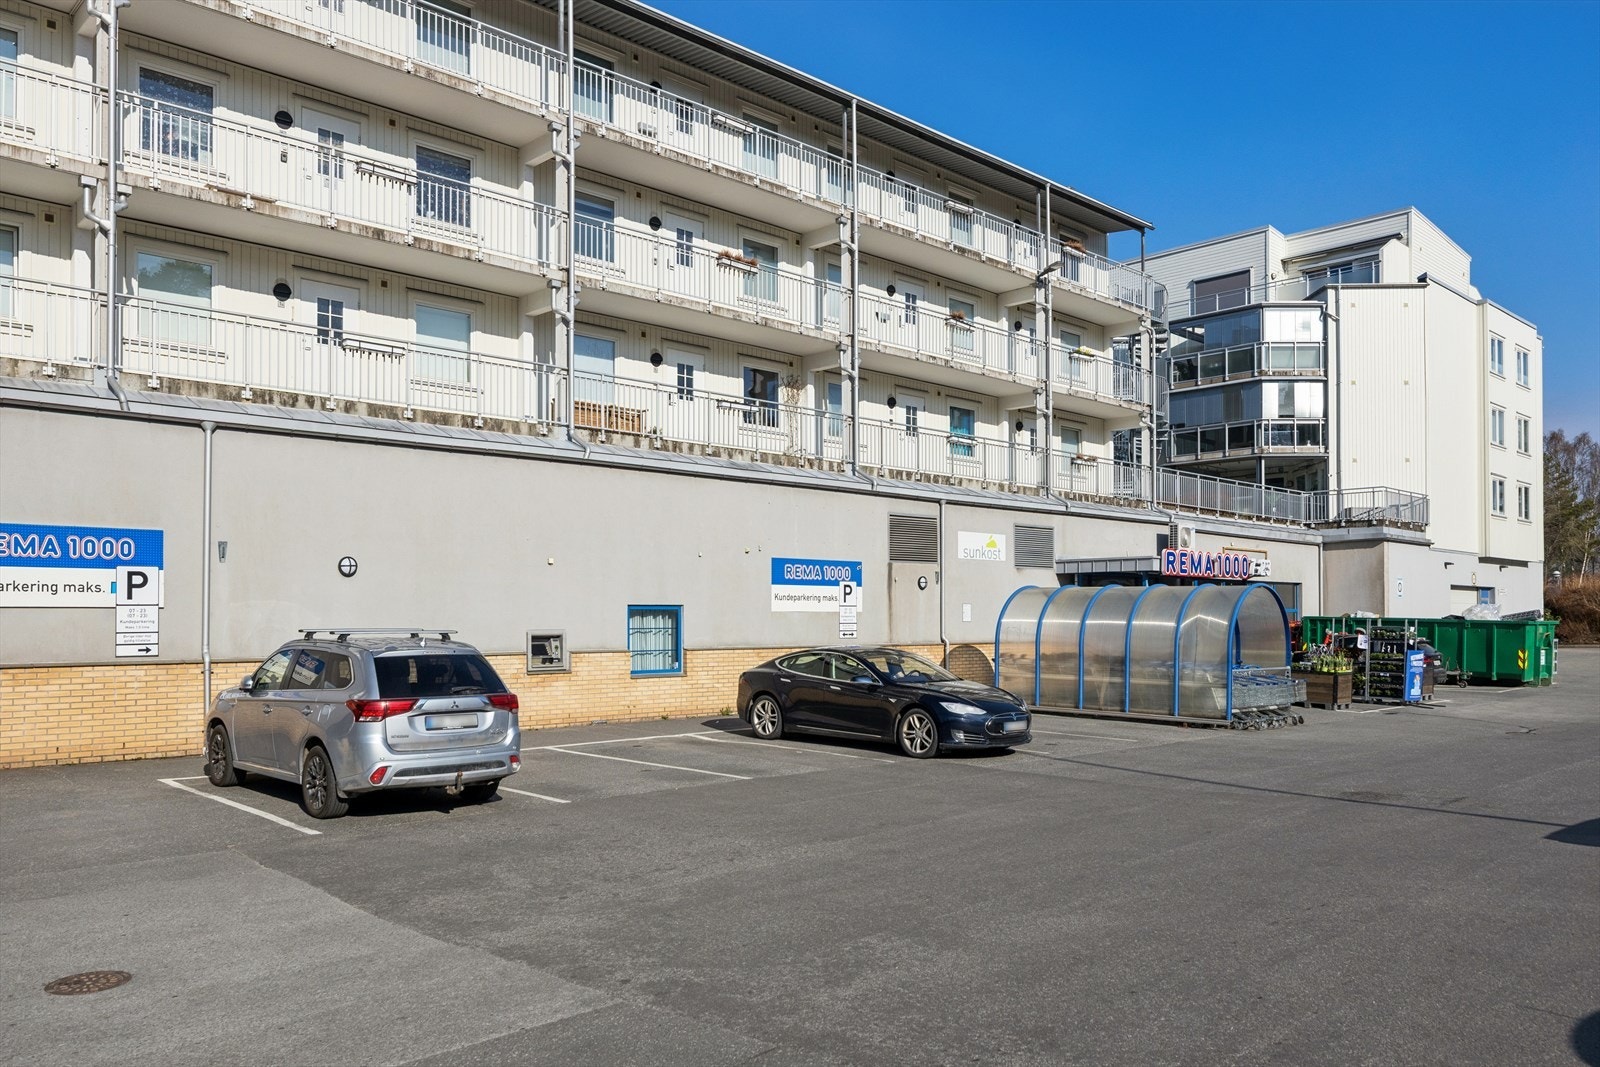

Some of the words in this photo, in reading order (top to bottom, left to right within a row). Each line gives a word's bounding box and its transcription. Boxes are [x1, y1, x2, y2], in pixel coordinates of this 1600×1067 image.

[67, 535, 135, 560] 1000
[963, 545, 1001, 560] sunkost
[784, 564, 822, 580] REMA
[824, 566, 851, 580] 1000
[1164, 549, 1214, 577] REMA
[1216, 553, 1249, 578] 1000
[63, 582, 106, 593] maks.
[126, 570, 149, 600] P
[843, 584, 853, 603] P
[774, 593, 821, 603] Kundeparkering
[822, 594, 840, 602] maks.
